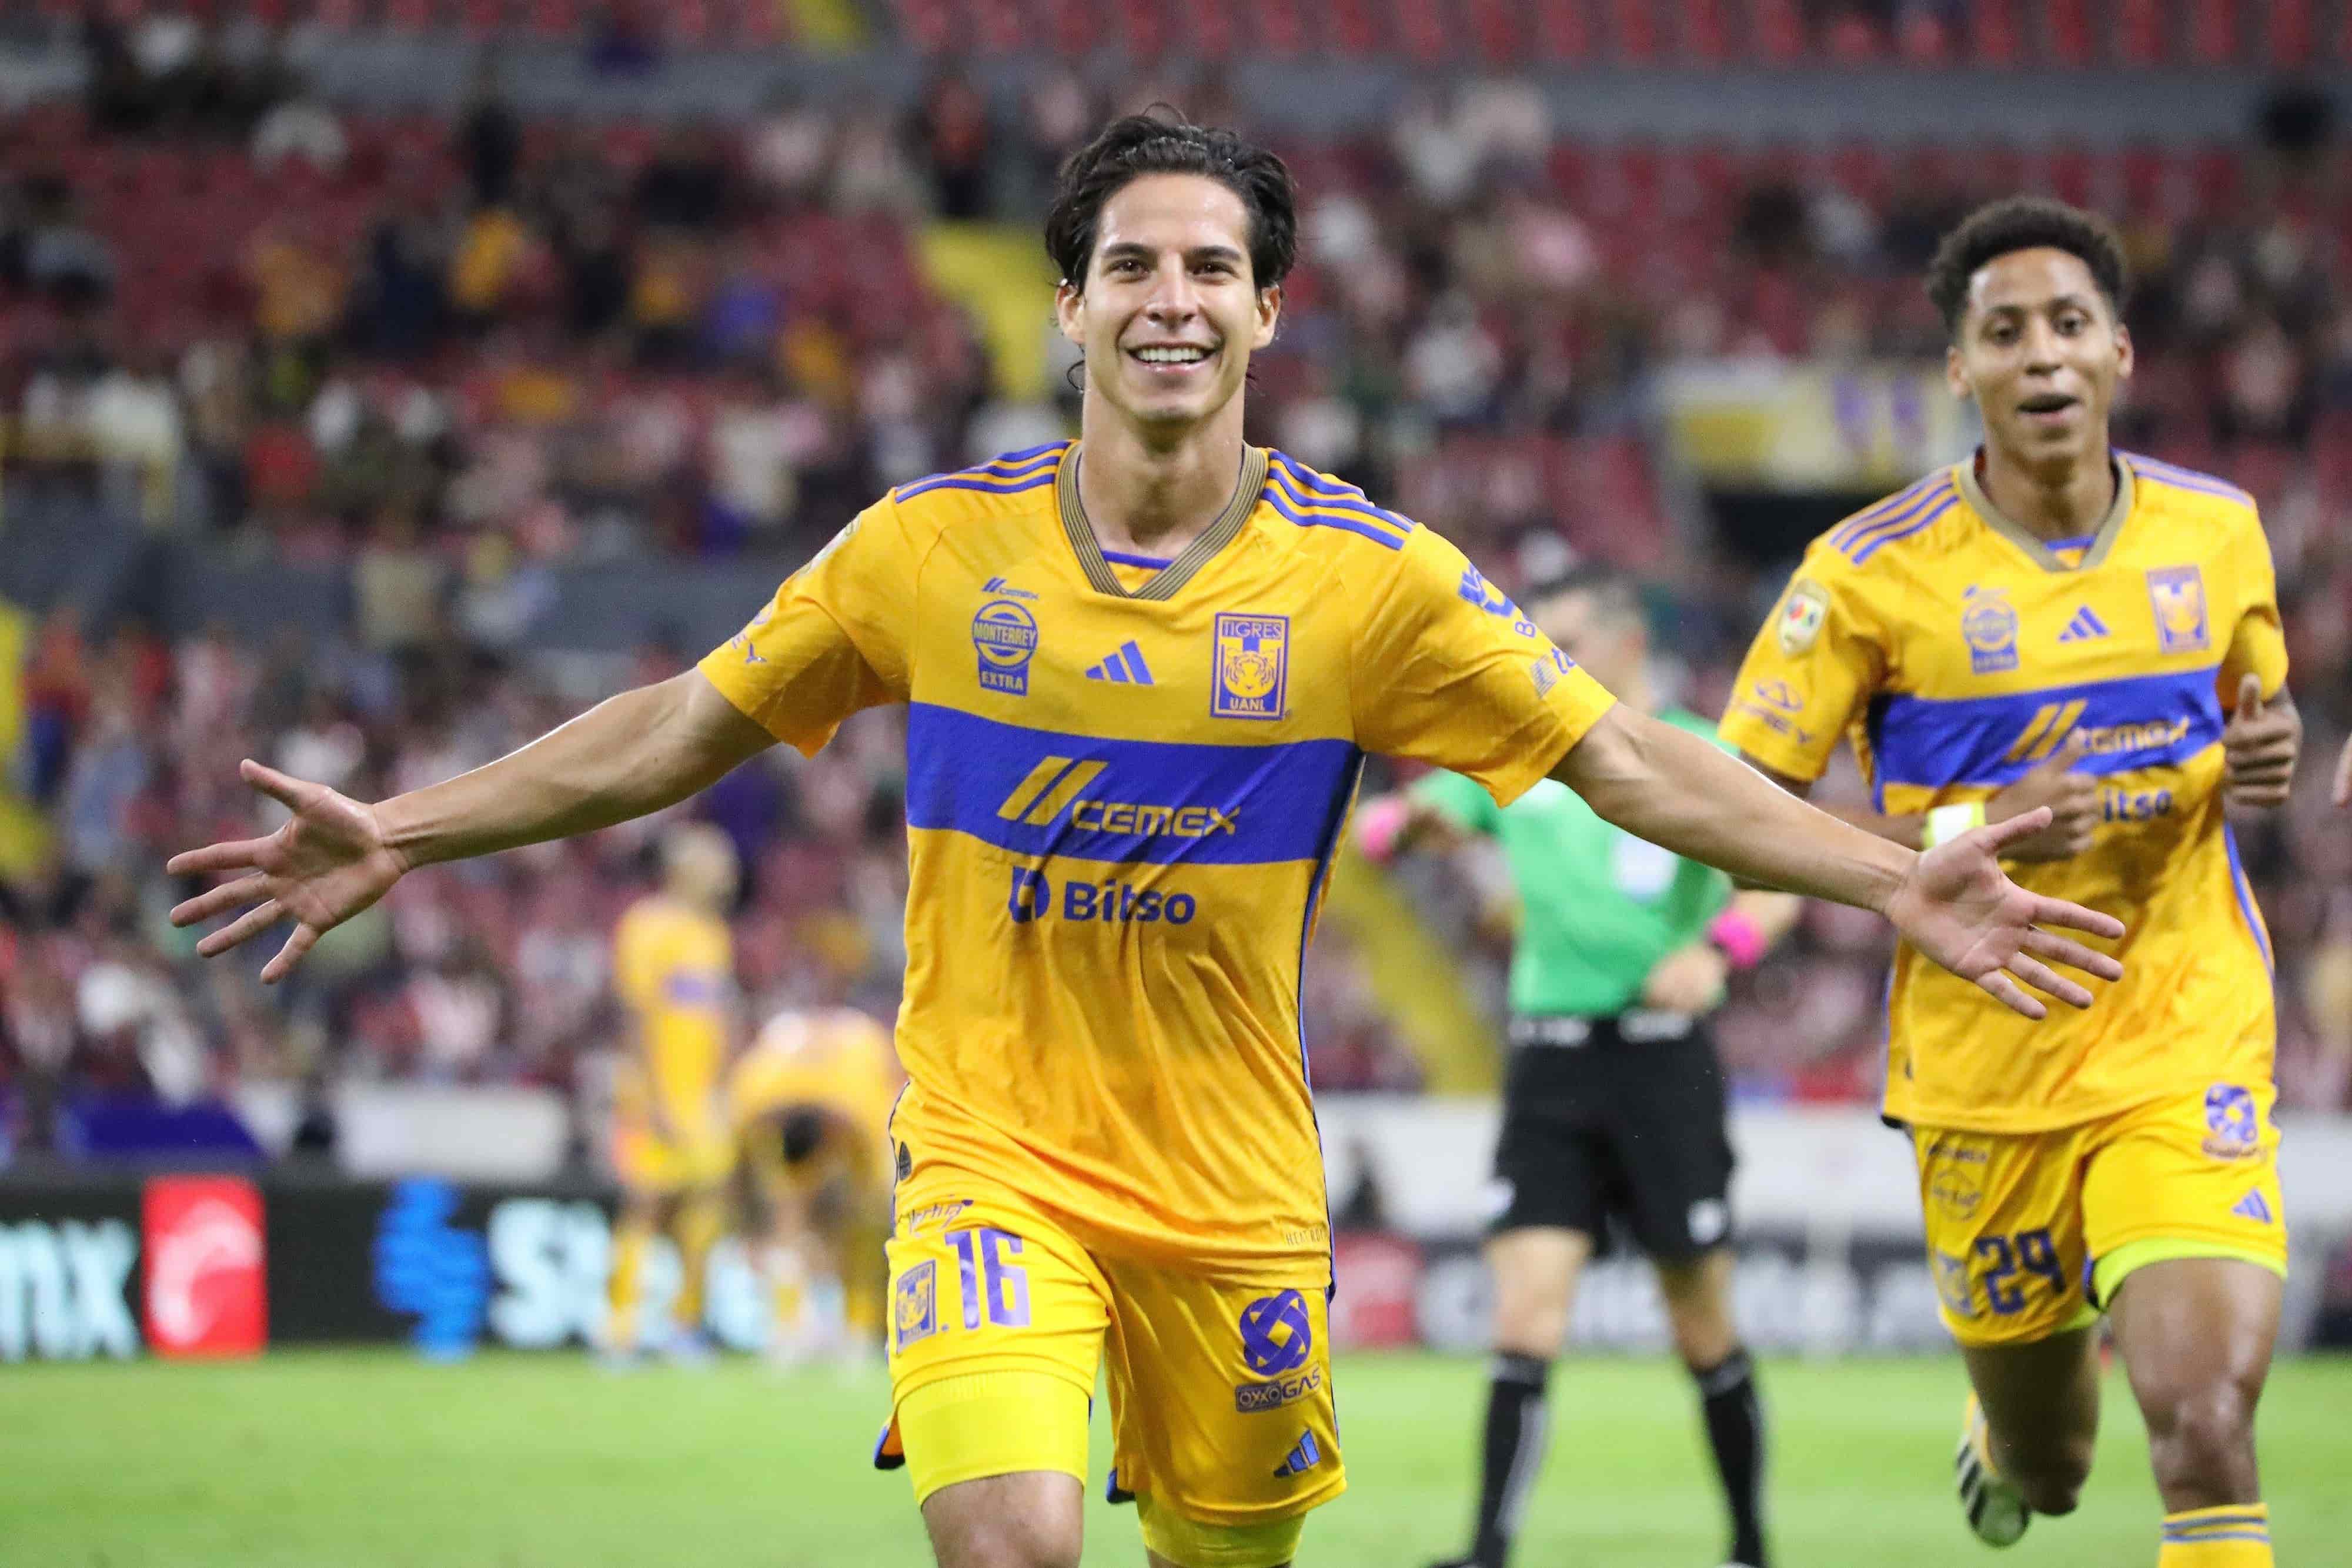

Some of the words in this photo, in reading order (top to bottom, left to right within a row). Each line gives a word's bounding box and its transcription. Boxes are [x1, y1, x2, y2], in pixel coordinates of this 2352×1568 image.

[973, 621, 1037, 646] MONTERREY
[1222, 620, 1282, 640] TIGRES
[981, 670, 1025, 691] EXTRA
[1230, 696, 1266, 711] UANL
[2089, 715, 2190, 754] EMEX
[1072, 800, 1241, 837] CEMEX
[2103, 788, 2172, 822] itso
[1063, 880, 1196, 925] Bitso
[944, 1227, 1031, 1330] 16
[1975, 1226, 2067, 1315] 29
[1239, 1385, 1281, 1407] OXXO
[1282, 1367, 1321, 1398] GAS
